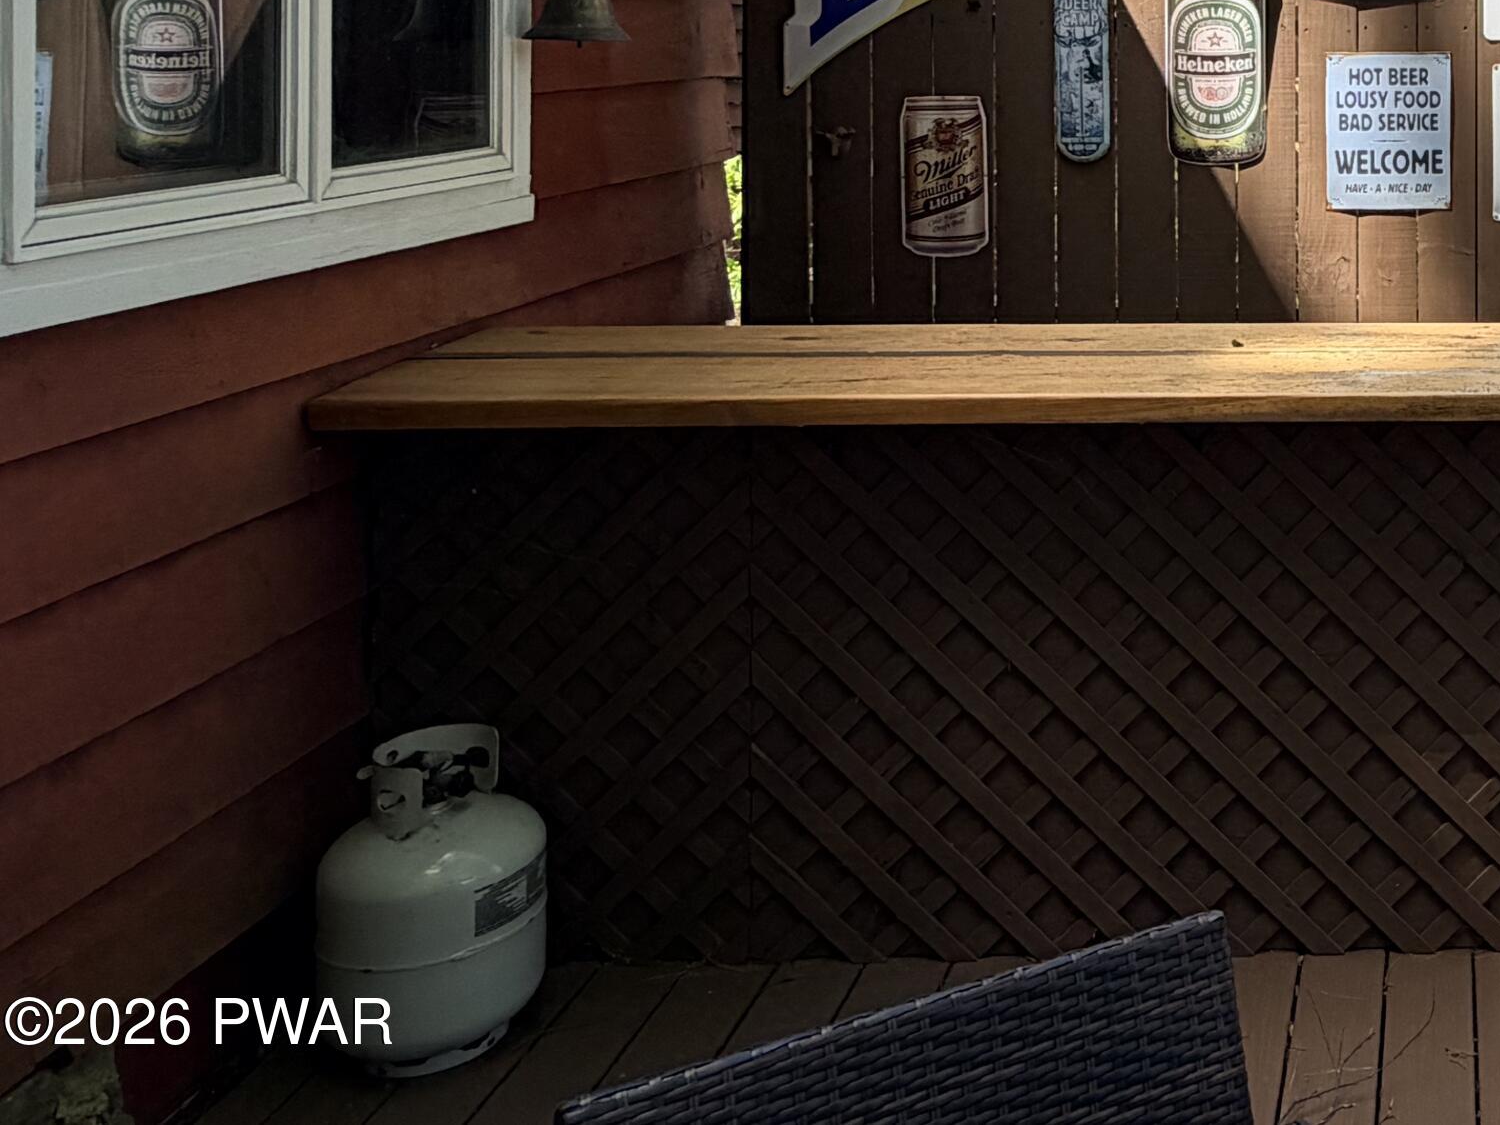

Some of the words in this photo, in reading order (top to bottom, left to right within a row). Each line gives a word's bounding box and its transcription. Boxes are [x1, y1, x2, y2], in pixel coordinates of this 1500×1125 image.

[1063, 10, 1099, 26] CAMP
[1211, 7, 1242, 24] LAGER
[1177, 54, 1254, 73] Heineken
[1348, 68, 1383, 86] HOT
[1388, 68, 1429, 86] BEER
[1336, 90, 1388, 109] LOUSY
[1394, 90, 1441, 109] FOOD
[1209, 113, 1220, 125] IN
[1339, 113, 1373, 131] BAD
[1378, 113, 1440, 131] SERVICE
[913, 145, 976, 184] Miller
[1334, 149, 1443, 175] WELCOME
[1345, 183, 1368, 193] HAVE
[1375, 183, 1381, 193] A
[1388, 183, 1408, 193] NICE
[1415, 183, 1432, 193] DAY
[929, 190, 966, 210] LIGHT
